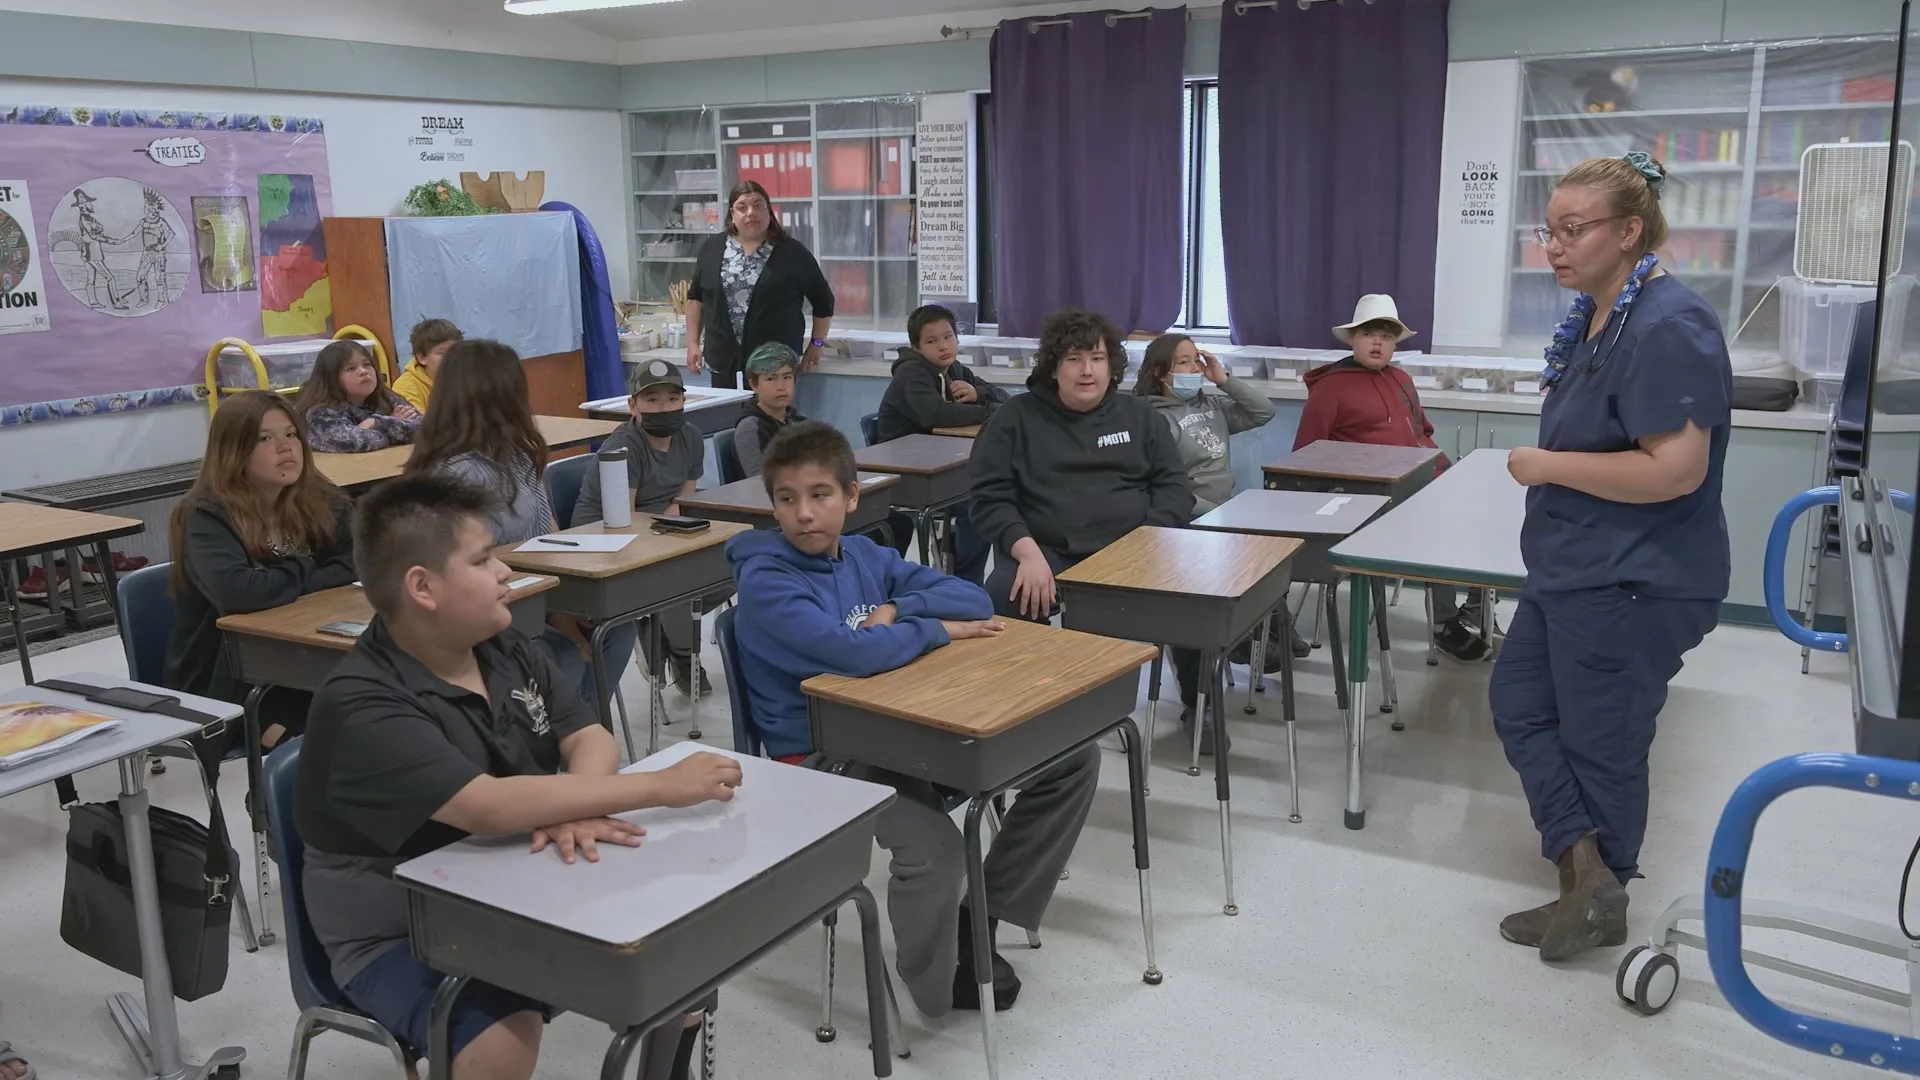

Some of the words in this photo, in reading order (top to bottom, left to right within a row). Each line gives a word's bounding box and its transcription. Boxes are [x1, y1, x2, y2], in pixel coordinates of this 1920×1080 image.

[421, 116, 465, 129] DREAM
[919, 124, 929, 133] LIVE
[930, 124, 944, 133] YOUR
[945, 123, 964, 132] DREAM
[154, 144, 201, 159] TREATIES
[420, 151, 445, 162] Believe
[1466, 160, 1496, 171] Don't
[919, 175, 939, 186] Laugh
[949, 175, 964, 185] loud
[1462, 172, 1499, 181] LOOK
[921, 185, 941, 198] Make
[1464, 182, 1495, 191] BACK
[1463, 192, 1496, 202] you're
[919, 200, 927, 208] Be
[927, 201, 940, 209] your
[940, 199, 952, 208] best
[952, 199, 964, 208] self
[1461, 209, 1494, 217] GOING
[1460, 217, 1477, 225] that
[920, 221, 948, 231] Dream
[949, 220, 964, 234] Big
[919, 232, 937, 241] Believe
[943, 233, 965, 241] miracles
[920, 262, 933, 271] Sing
[920, 270, 937, 282] Fall
[939, 271, 948, 281] in
[949, 271, 965, 281] love
[920, 282, 937, 293] Today
[943, 283, 952, 291] the
